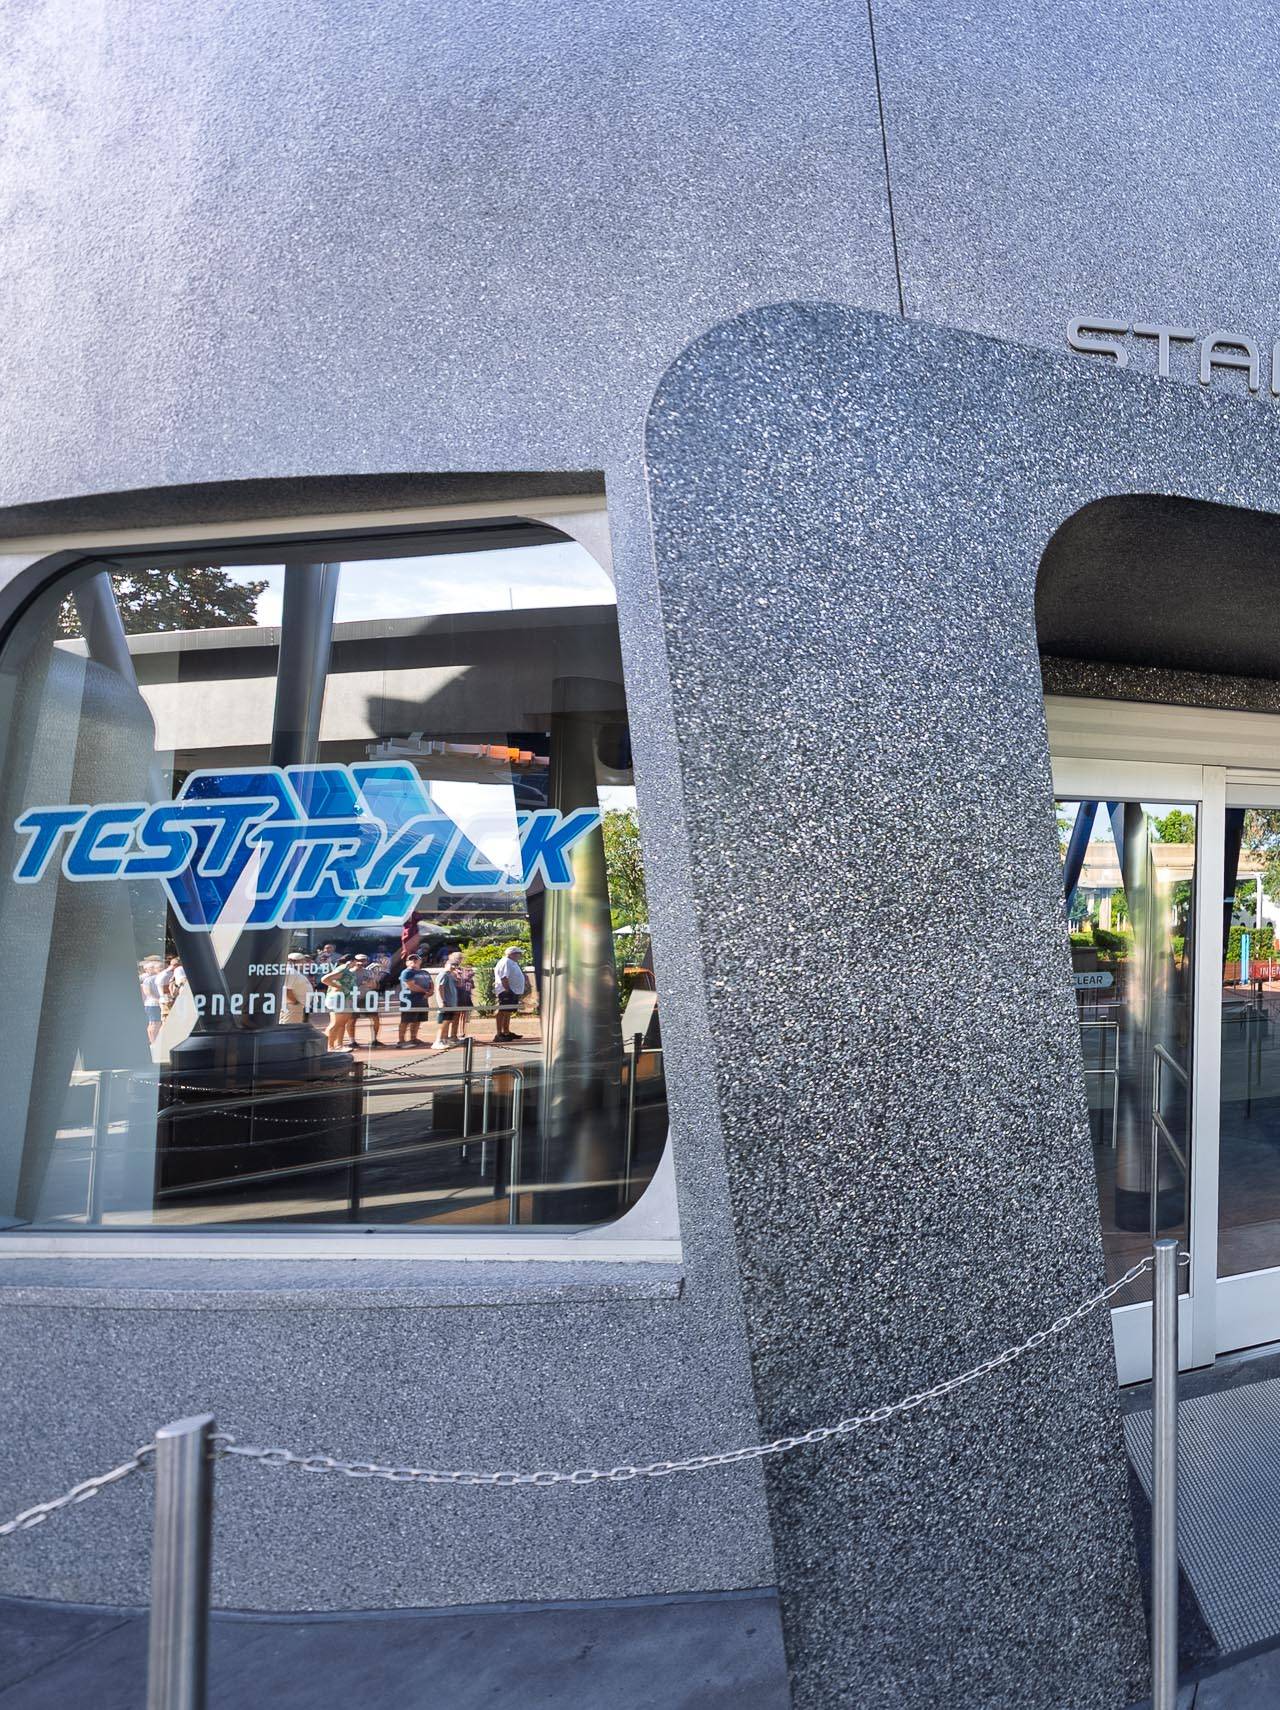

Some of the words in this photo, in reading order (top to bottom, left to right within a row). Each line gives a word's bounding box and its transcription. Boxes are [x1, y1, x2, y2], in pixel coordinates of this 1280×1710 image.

[14, 797, 280, 884] TEST
[245, 807, 600, 898] TRACK
[248, 962, 319, 976] PRESENTED
[321, 962, 338, 975] BY
[1259, 967, 1269, 978] IN
[182, 985, 289, 1016] eneral
[305, 985, 412, 1013] motors
